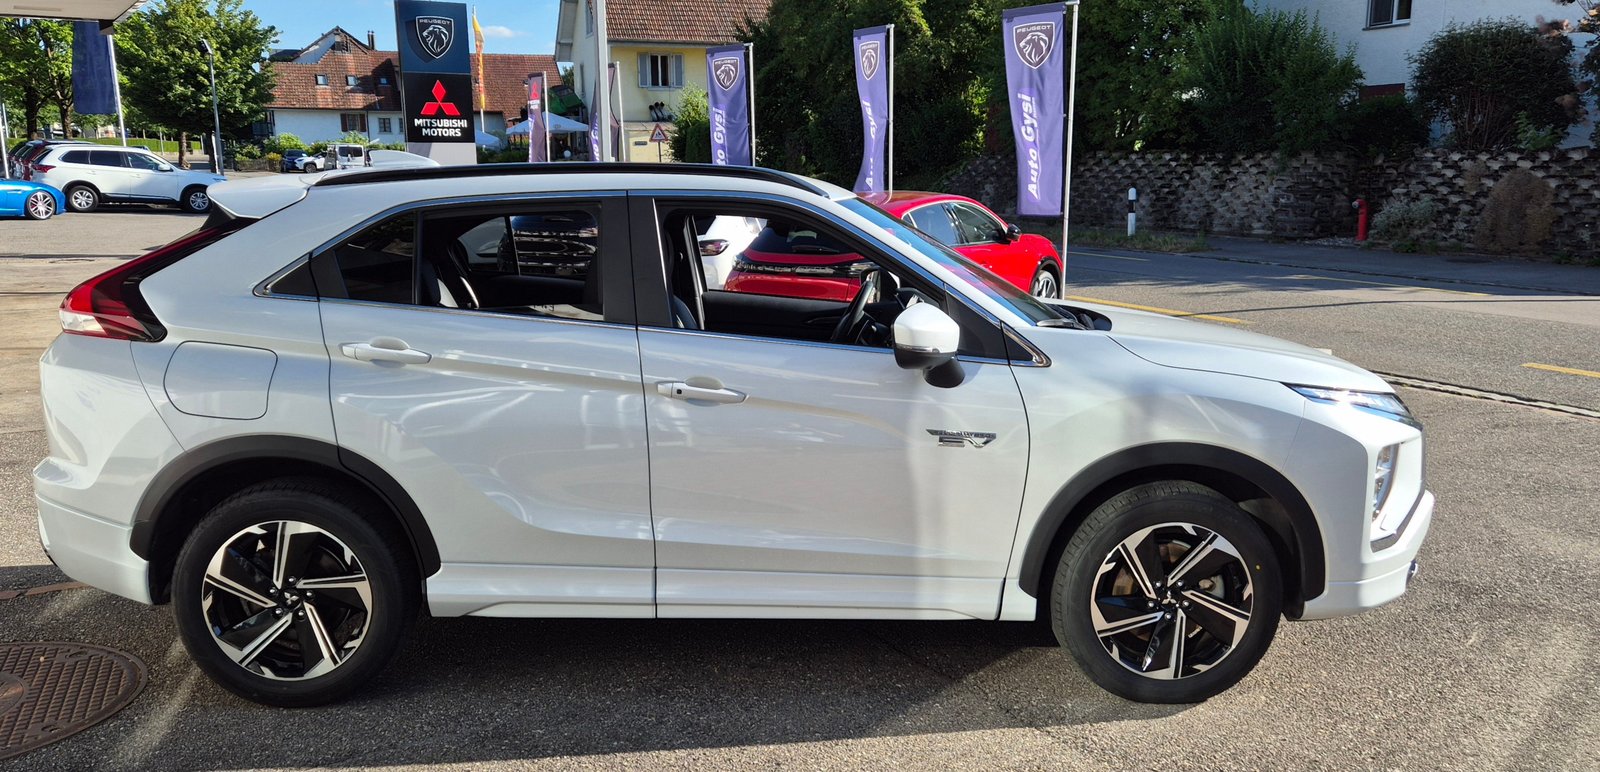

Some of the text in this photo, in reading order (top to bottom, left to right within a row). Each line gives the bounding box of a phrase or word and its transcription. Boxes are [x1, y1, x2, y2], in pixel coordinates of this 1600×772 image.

[1016, 25, 1052, 33] PEUGEOT
[414, 118, 468, 128] MITSUBISHI
[713, 107, 726, 144] Gysi
[422, 128, 461, 137] MOTORS
[1017, 93, 1039, 200] Auto Gysi
